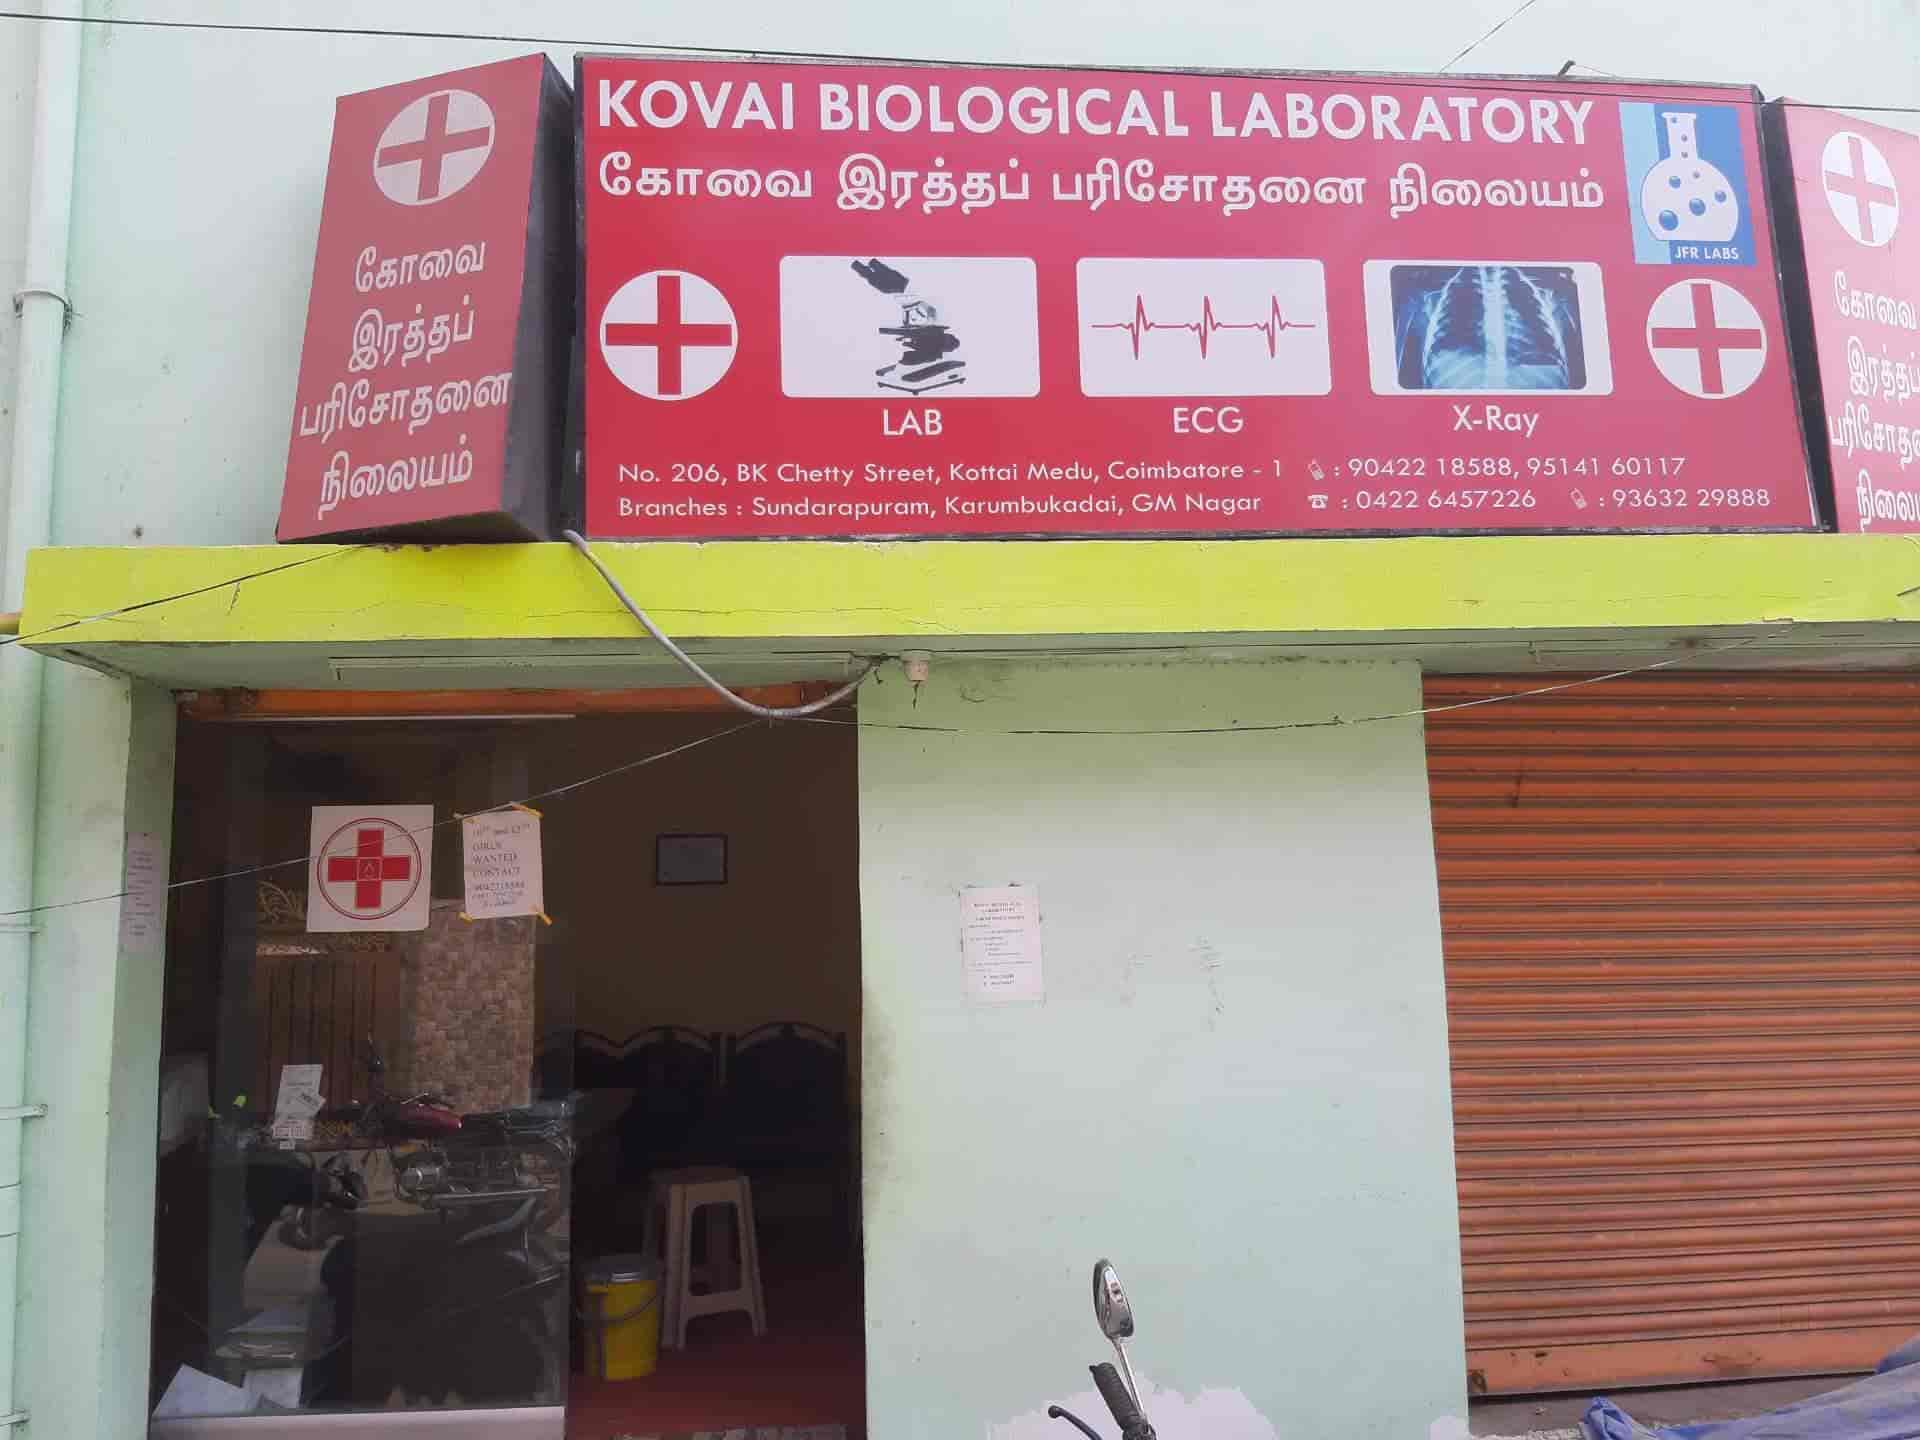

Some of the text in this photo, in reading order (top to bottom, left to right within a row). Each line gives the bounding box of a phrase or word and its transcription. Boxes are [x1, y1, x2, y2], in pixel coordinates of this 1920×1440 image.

[599, 79, 1595, 145] KOVAI BIOLOGICAL LABORATORY
[599, 151, 1604, 219] கோவை இரத்தப் பரிசோதனை நிலையம்
[355, 241, 486, 293] கோவை
[1674, 245, 1739, 260] JFR LABS
[1834, 270, 1917, 330] கோவை
[347, 293, 475, 373] இரத்தப்
[299, 371, 513, 444] பரிசோதனை
[883, 408, 943, 436] LAB
[1173, 406, 1244, 434] ECG
[1452, 404, 1539, 438] X-Ray
[316, 432, 474, 521] நிலையம்
[619, 463, 660, 483] No.
[671, 463, 728, 486] 206,
[737, 463, 768, 482] BK
[777, 463, 854, 487] Chetty
[864, 463, 941, 486] Street,
[950, 463, 1017, 481] Kottai
[1027, 461, 1100, 484] Medu,
[1107, 460, 1244, 480] Coimbatore
[1273, 459, 1281, 477] 1
[1348, 457, 1425, 477] 90422
[1437, 457, 1519, 480] 18588,
[1527, 457, 1598, 476] 95141
[1611, 457, 1686, 476] 60117
[619, 497, 728, 517] Branches
[752, 496, 937, 521] Sundarapuram,
[945, 494, 1124, 516] Karumbukadai,
[1131, 493, 1177, 513] GM
[1185, 493, 1261, 516] Nagar
[1356, 490, 1419, 510] 0422
[1427, 489, 1537, 509] 6457226
[1612, 488, 1688, 508] 93632
[1696, 488, 1771, 507] 29888
